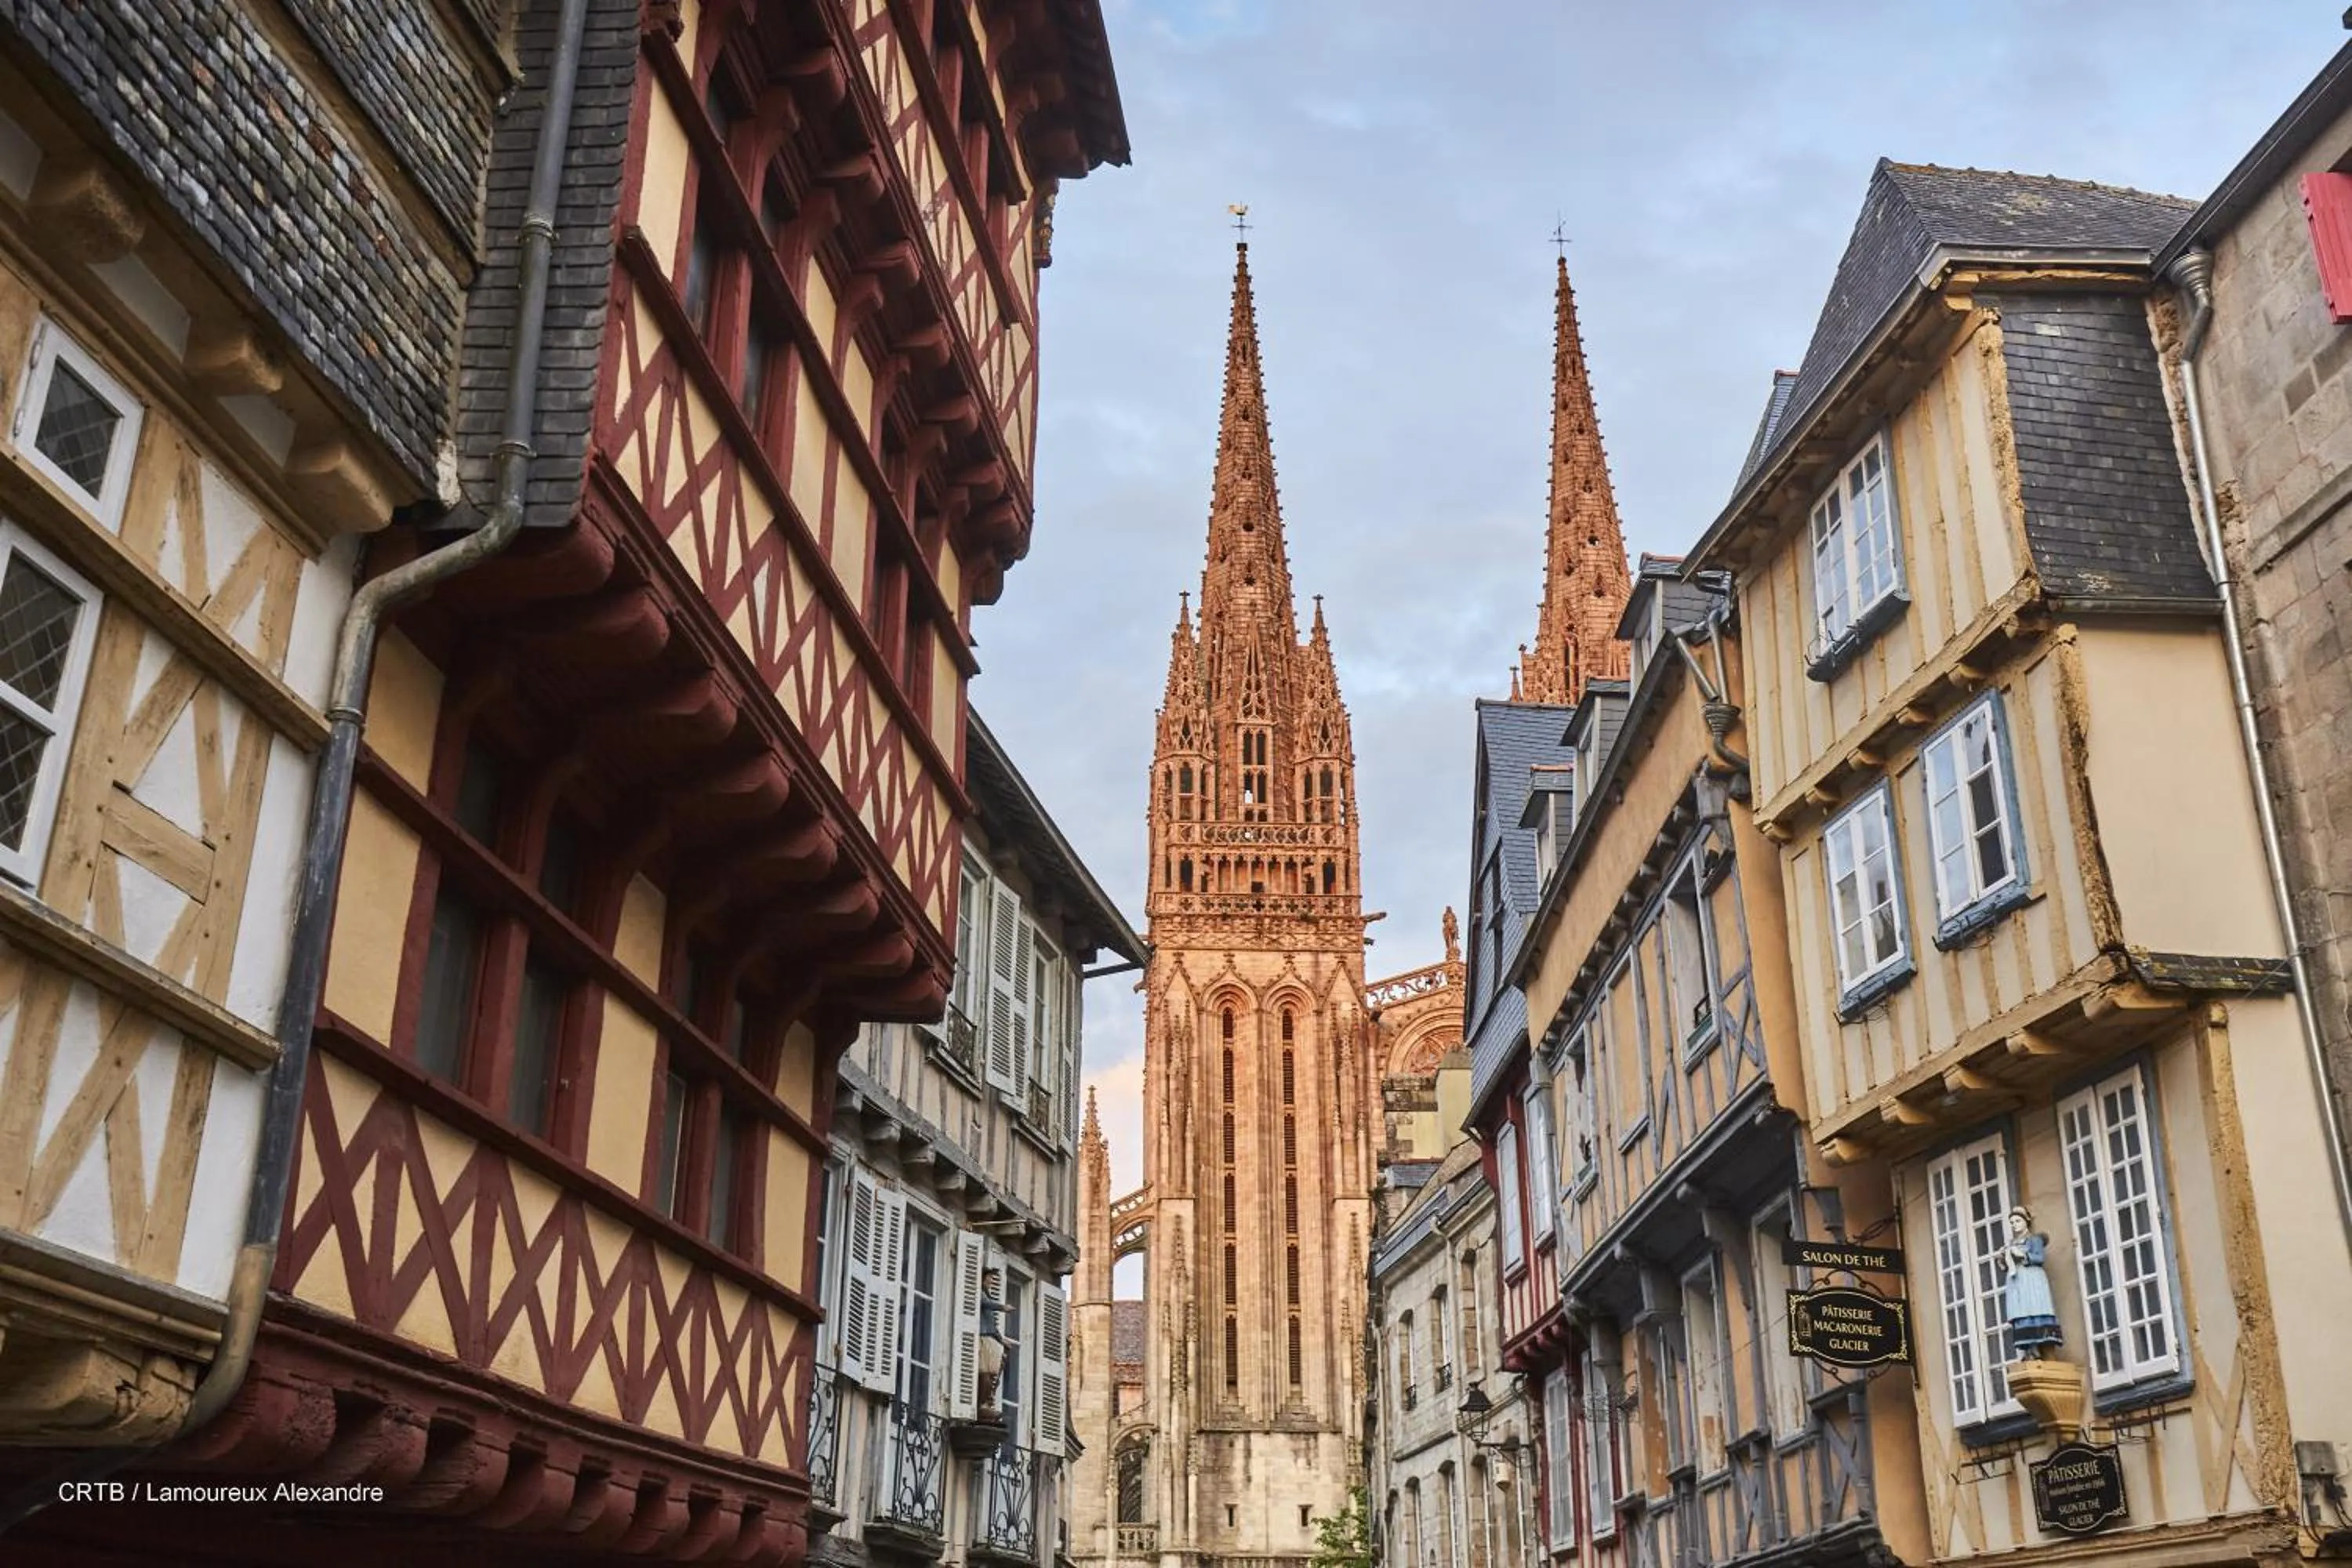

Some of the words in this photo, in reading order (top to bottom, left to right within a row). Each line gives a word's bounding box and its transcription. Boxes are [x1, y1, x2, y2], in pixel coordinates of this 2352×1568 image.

[1803, 1250, 1842, 1264] SALON
[1845, 1254, 1860, 1265] DE
[1862, 1255, 1887, 1267] THÉ
[1821, 1304, 1873, 1320] PÂTISSERIE
[1813, 1319, 1882, 1336] MACARONERIE
[1829, 1338, 1869, 1352] GLACIER
[2048, 1460, 2100, 1483] PÂTISSERIE
[2058, 1503, 2078, 1515] SALON
[2078, 1501, 2089, 1511] DE
[2069, 1514, 2093, 1526] GLACIER
